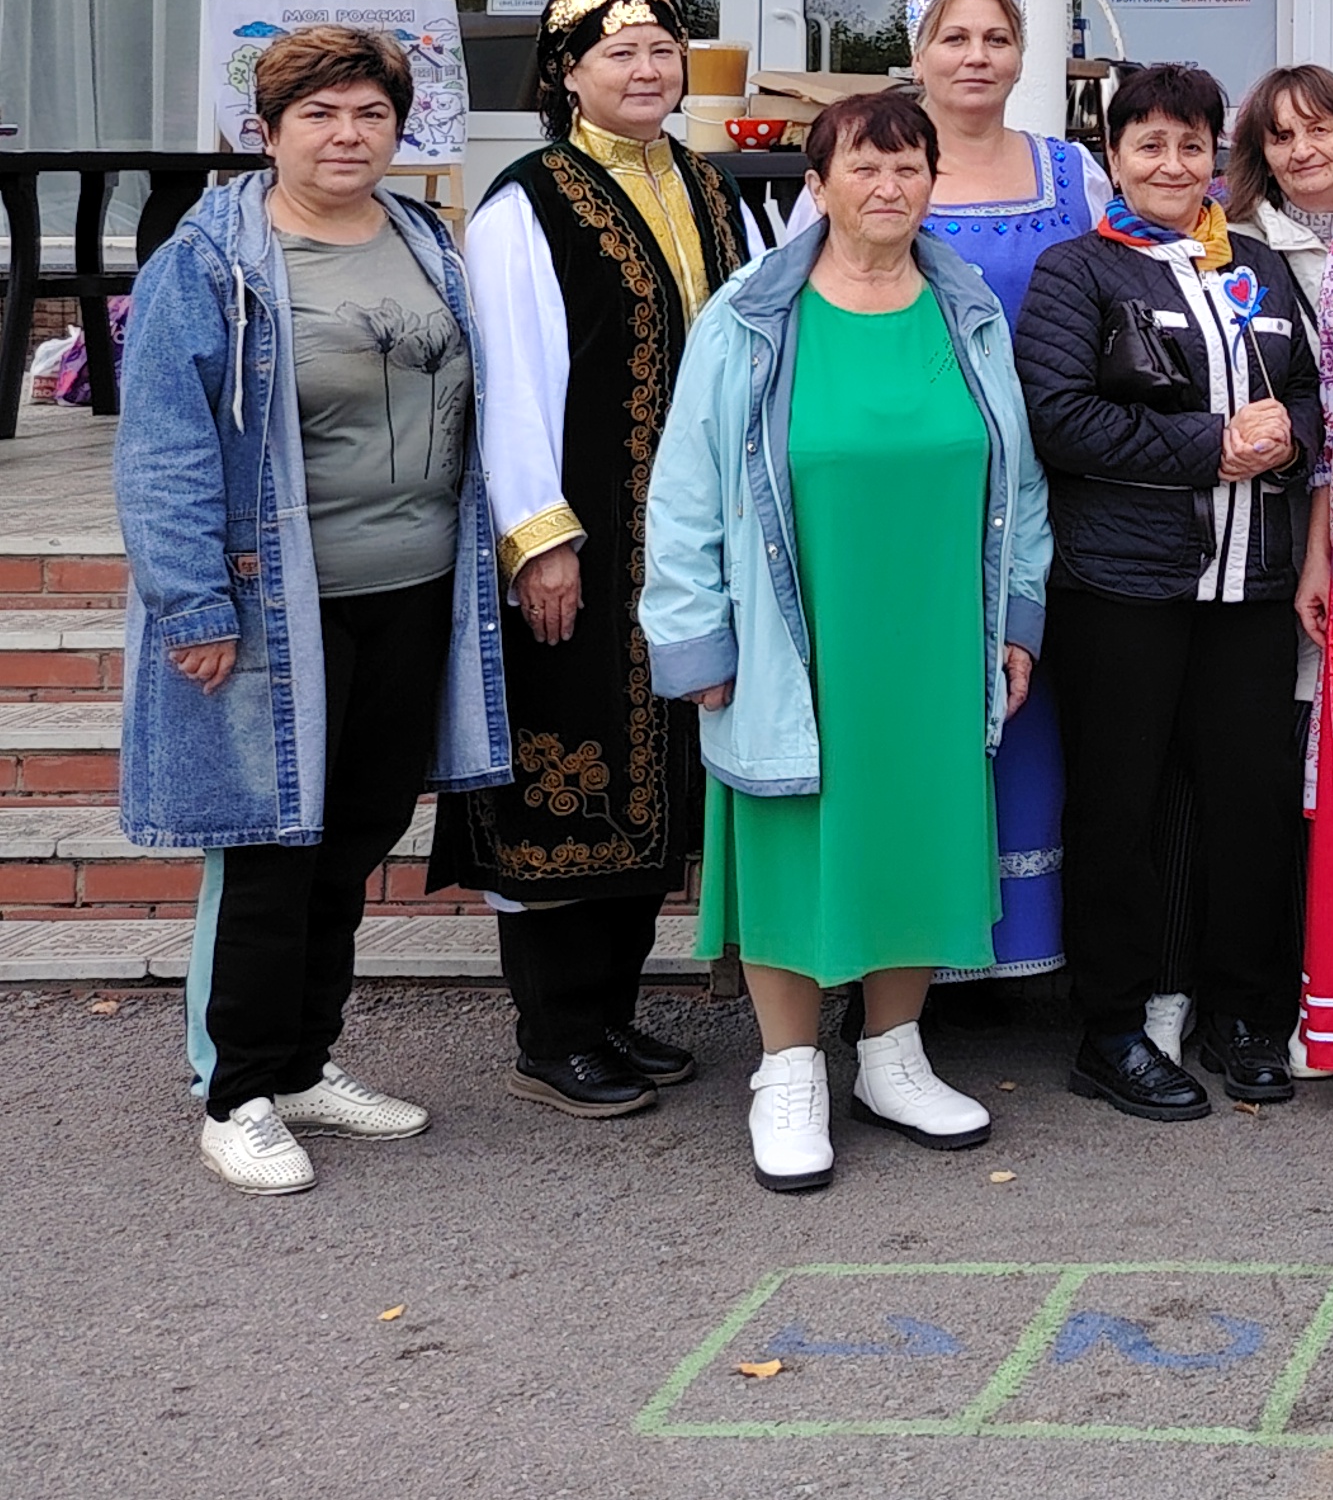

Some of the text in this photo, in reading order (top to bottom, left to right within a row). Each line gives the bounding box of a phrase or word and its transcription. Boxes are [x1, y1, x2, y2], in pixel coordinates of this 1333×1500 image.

[282, 9, 416, 23] МОЯ РОССИЯ
[767, 1314, 963, 1358] 1
[1050, 1309, 1265, 1369] 2
